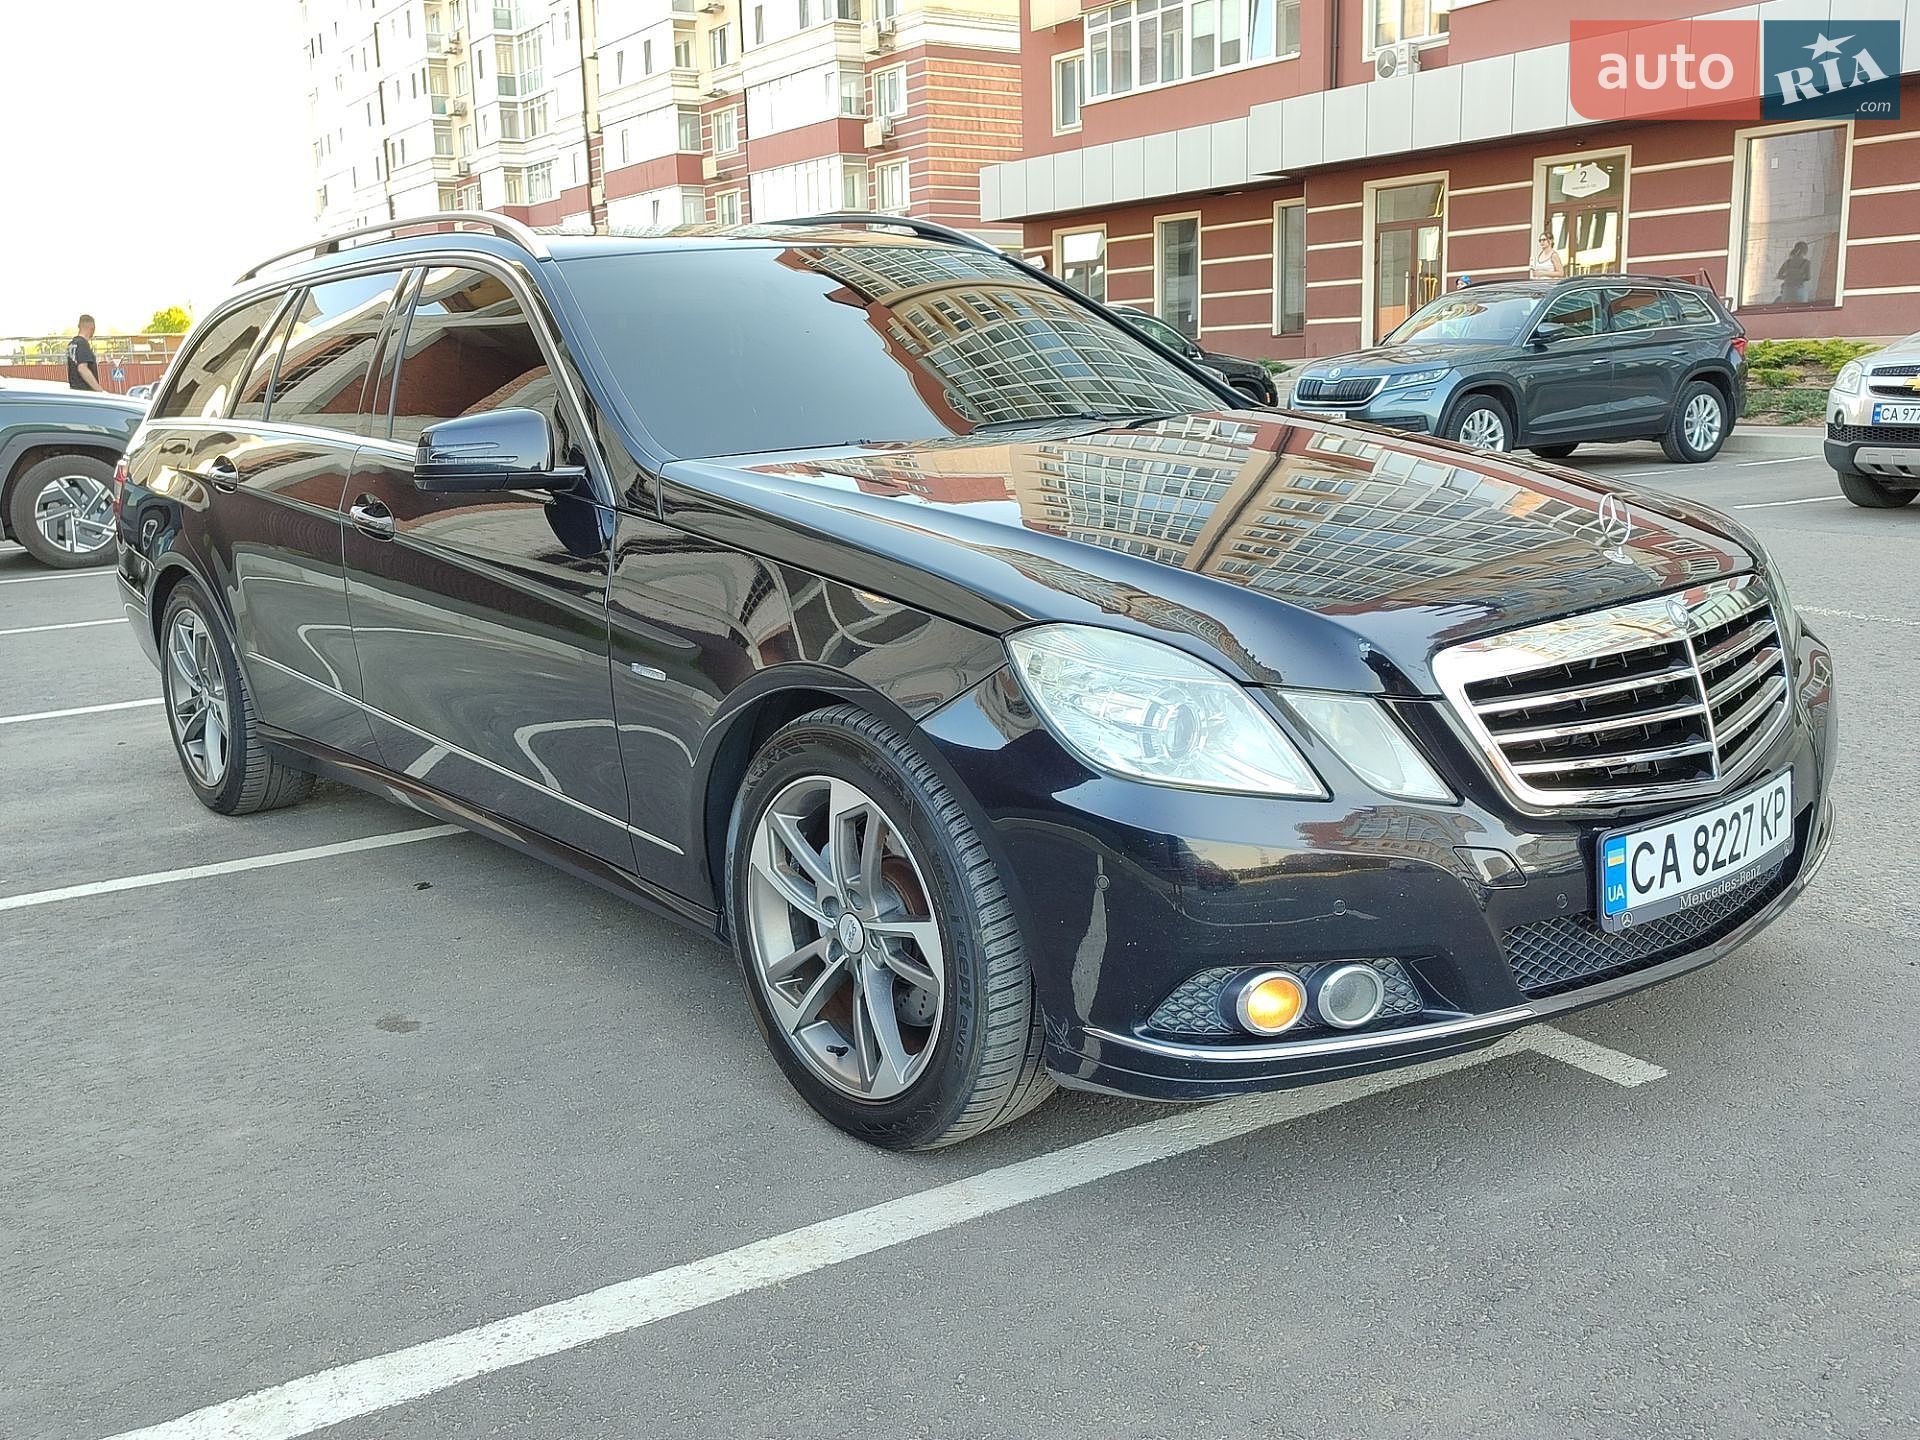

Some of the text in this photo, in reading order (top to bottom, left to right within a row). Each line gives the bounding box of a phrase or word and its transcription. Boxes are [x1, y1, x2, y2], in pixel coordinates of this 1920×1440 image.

[1579, 170, 1588, 184] 2
[1881, 407, 1898, 421] CA
[1631, 785, 1786, 895] CA 8227 KP
[1607, 883, 1625, 902] UA
[1679, 864, 1762, 910] Mercedes-Benz
